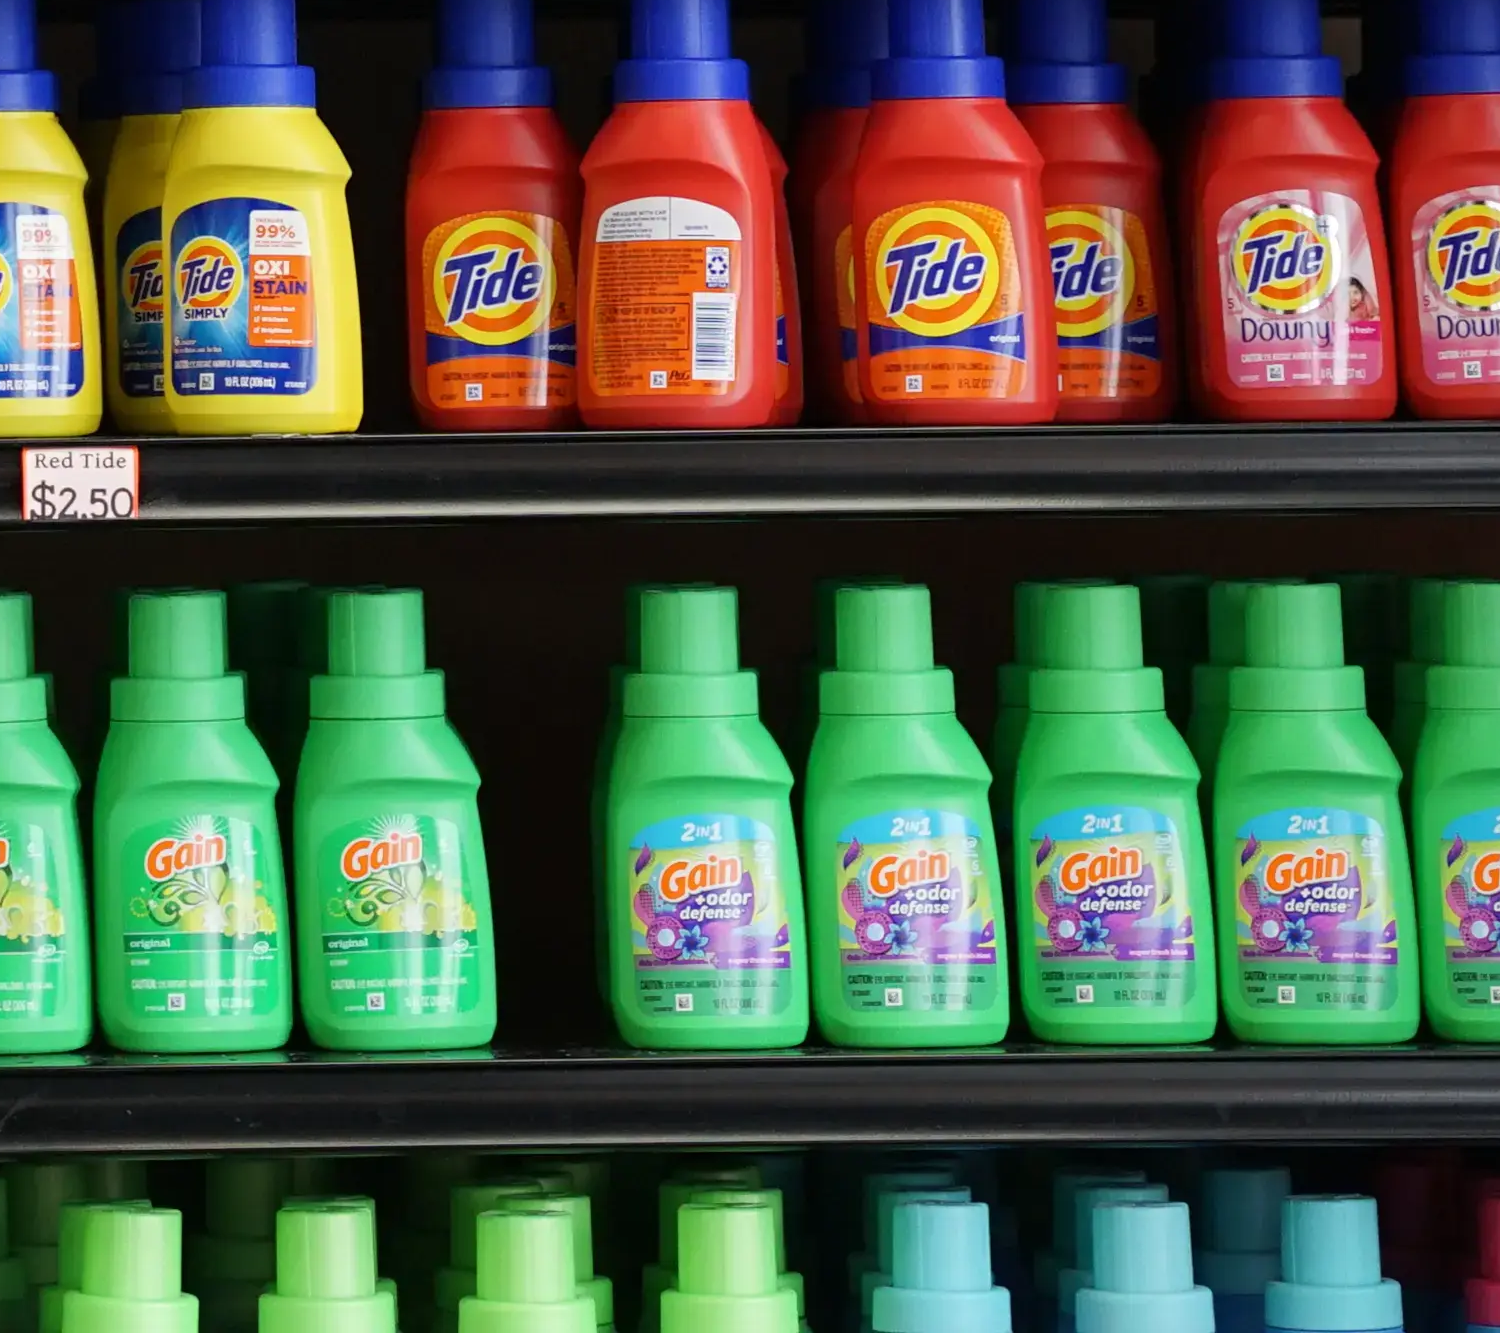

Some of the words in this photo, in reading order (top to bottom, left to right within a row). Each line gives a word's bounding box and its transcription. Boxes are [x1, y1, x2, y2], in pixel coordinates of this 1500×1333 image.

[179, 259, 235, 305] Tide
[444, 247, 543, 326] Tide
[884, 239, 985, 313] Tide
[35, 452, 74, 469] Red
[81, 452, 127, 469] Tide
[31, 480, 134, 521] $2.50
